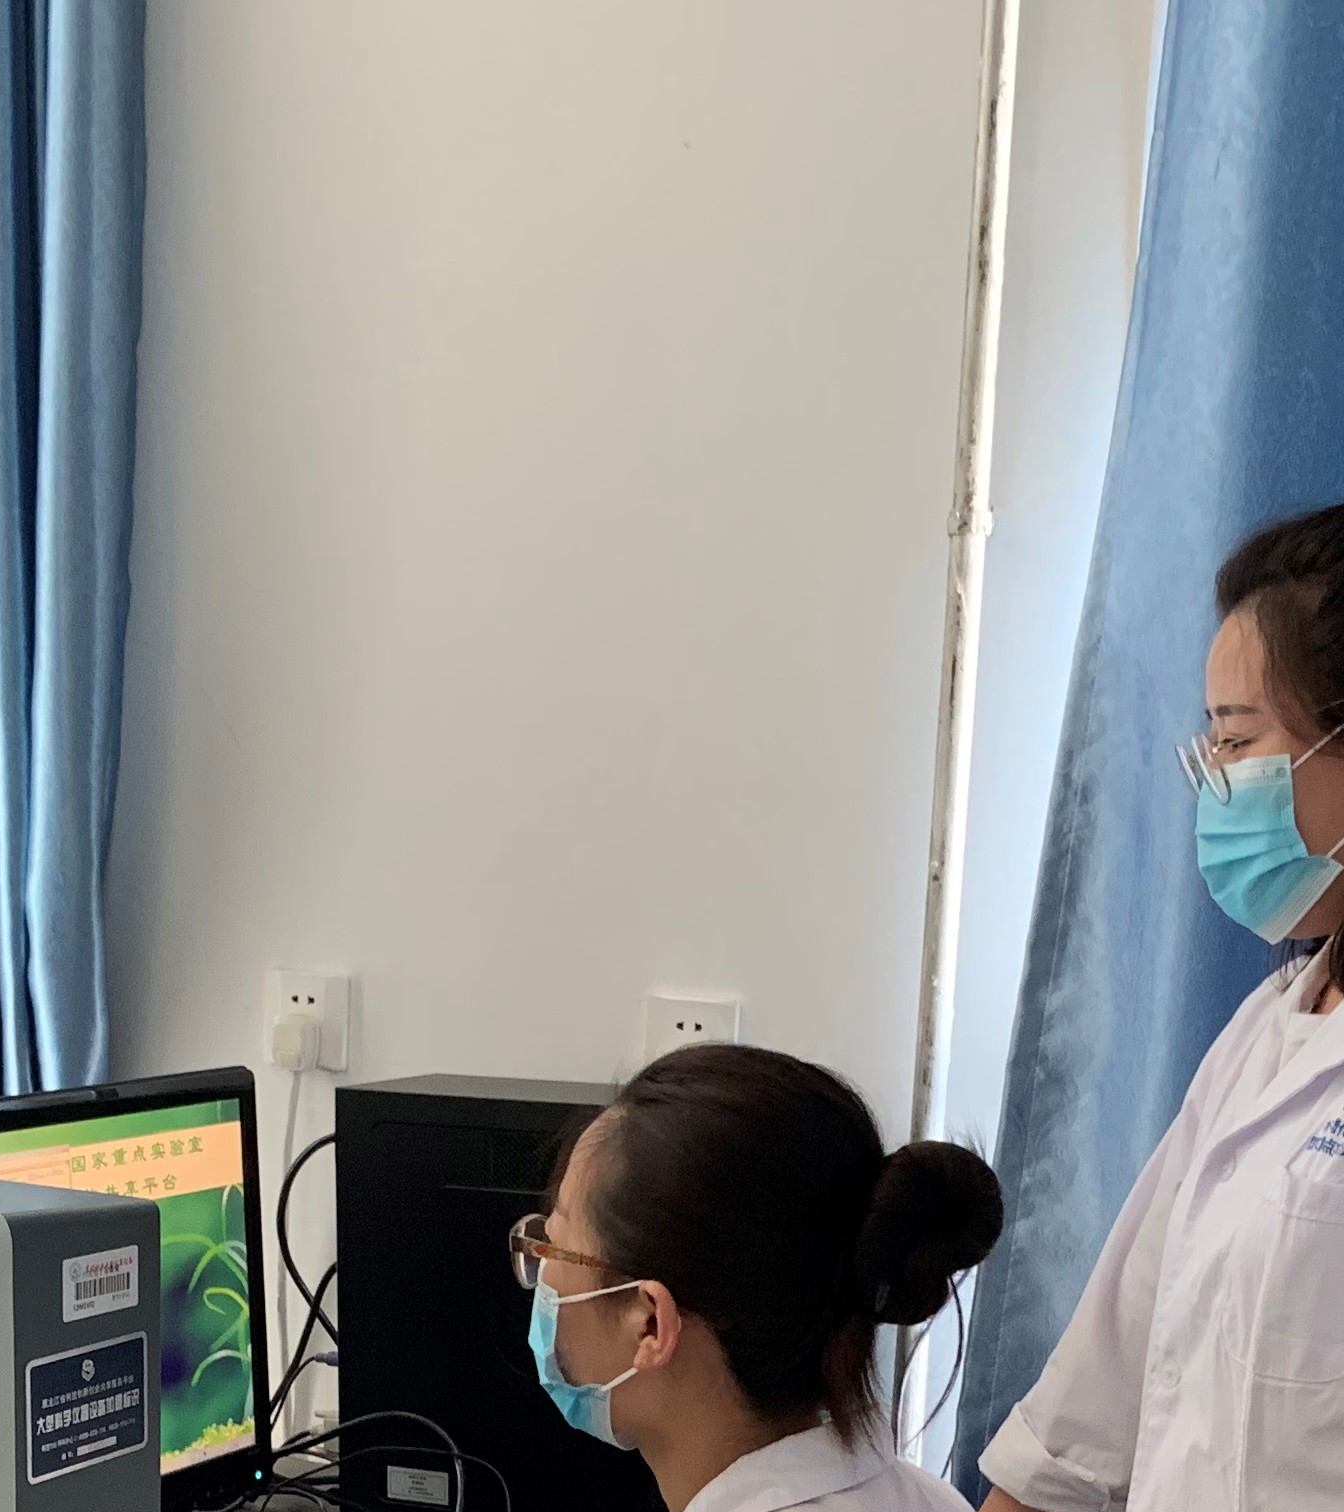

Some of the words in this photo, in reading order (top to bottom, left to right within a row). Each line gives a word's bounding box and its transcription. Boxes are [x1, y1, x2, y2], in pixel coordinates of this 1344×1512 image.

[70, 1136, 204, 1172] 国家重点实验室
[86, 1173, 177, 1198] 共享平台
